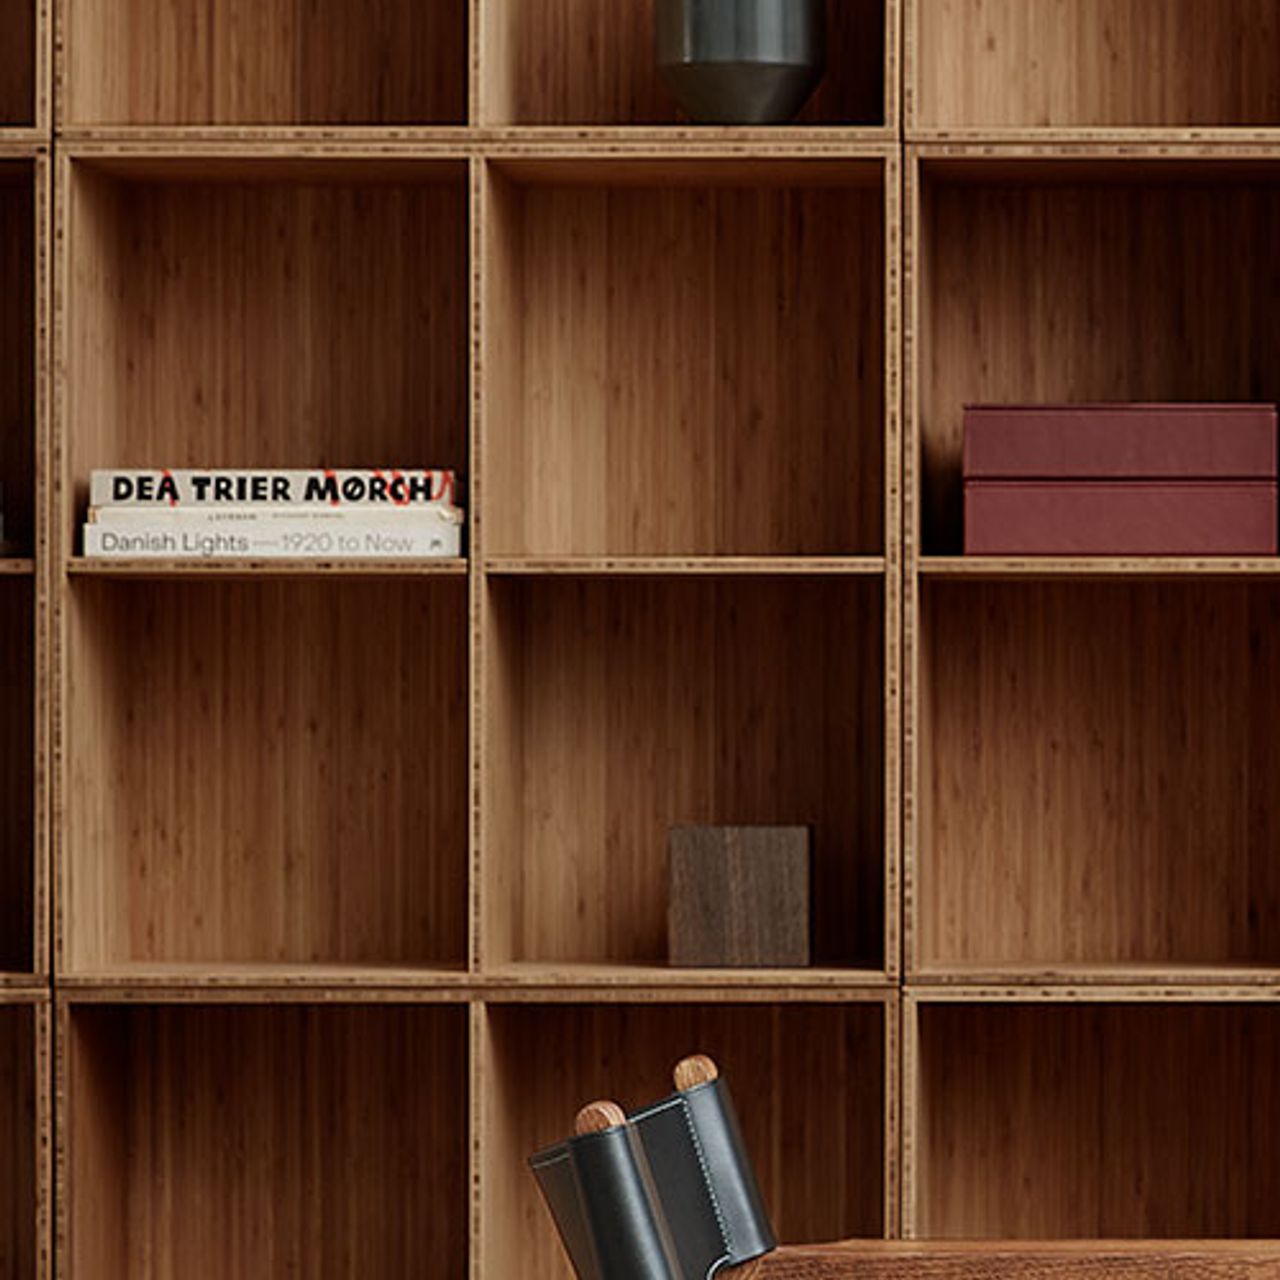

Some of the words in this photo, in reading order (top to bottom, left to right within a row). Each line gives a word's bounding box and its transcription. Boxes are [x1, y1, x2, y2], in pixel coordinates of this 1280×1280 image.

[113, 476, 180, 501] DEA
[192, 476, 291, 501] TRIER
[304, 476, 433, 502] MØRCH
[102, 532, 176, 552] Danish
[183, 532, 248, 557] Lights
[282, 533, 333, 553] 1920
[338, 535, 361, 553] to
[365, 534, 415, 553] Now
